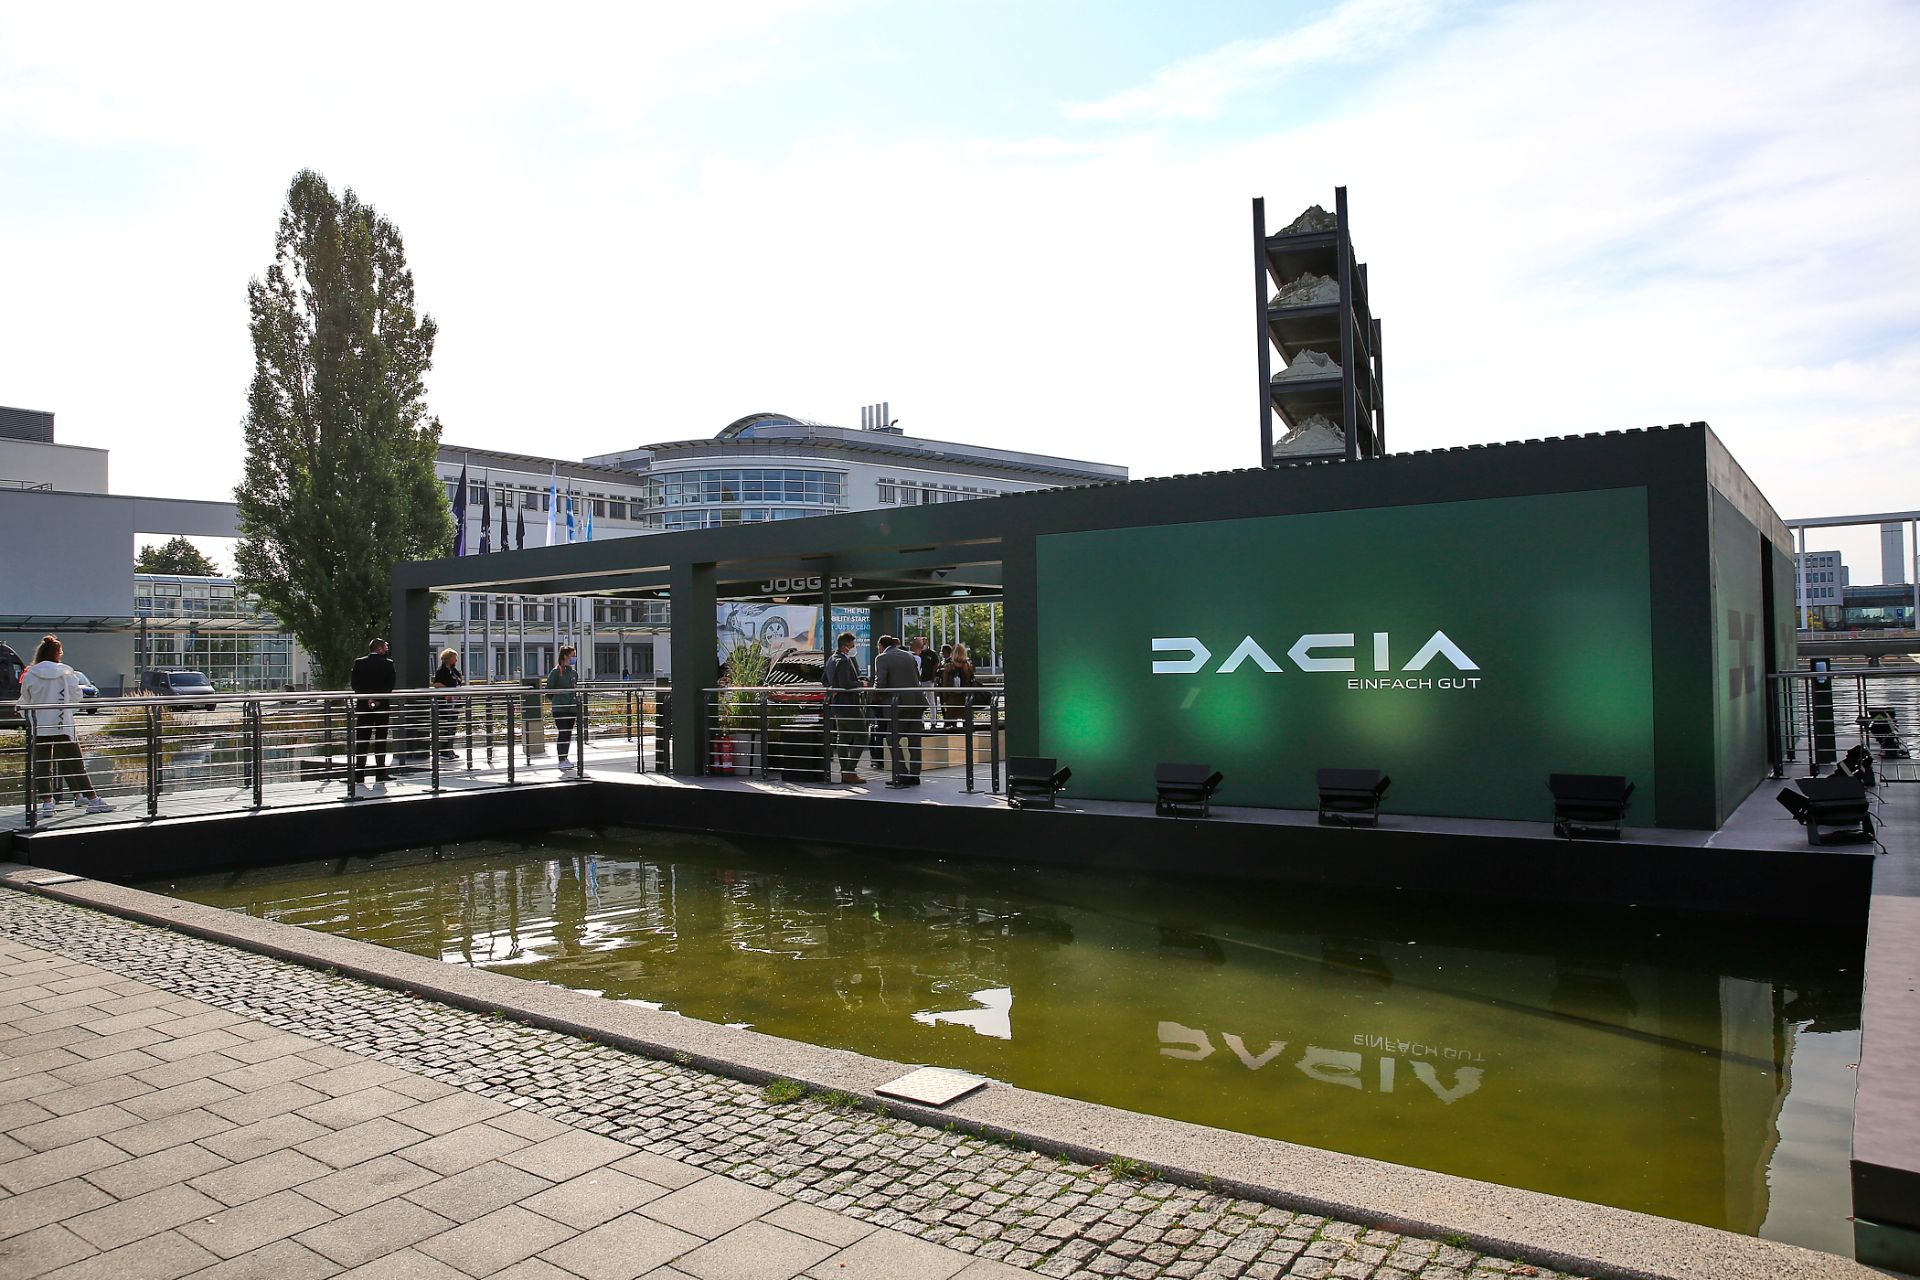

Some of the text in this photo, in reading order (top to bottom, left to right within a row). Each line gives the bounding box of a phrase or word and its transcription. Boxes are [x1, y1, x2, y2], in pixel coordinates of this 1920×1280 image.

[1152, 630, 1480, 674] DACIA
[1347, 677, 1482, 690] EINFACH GUT
